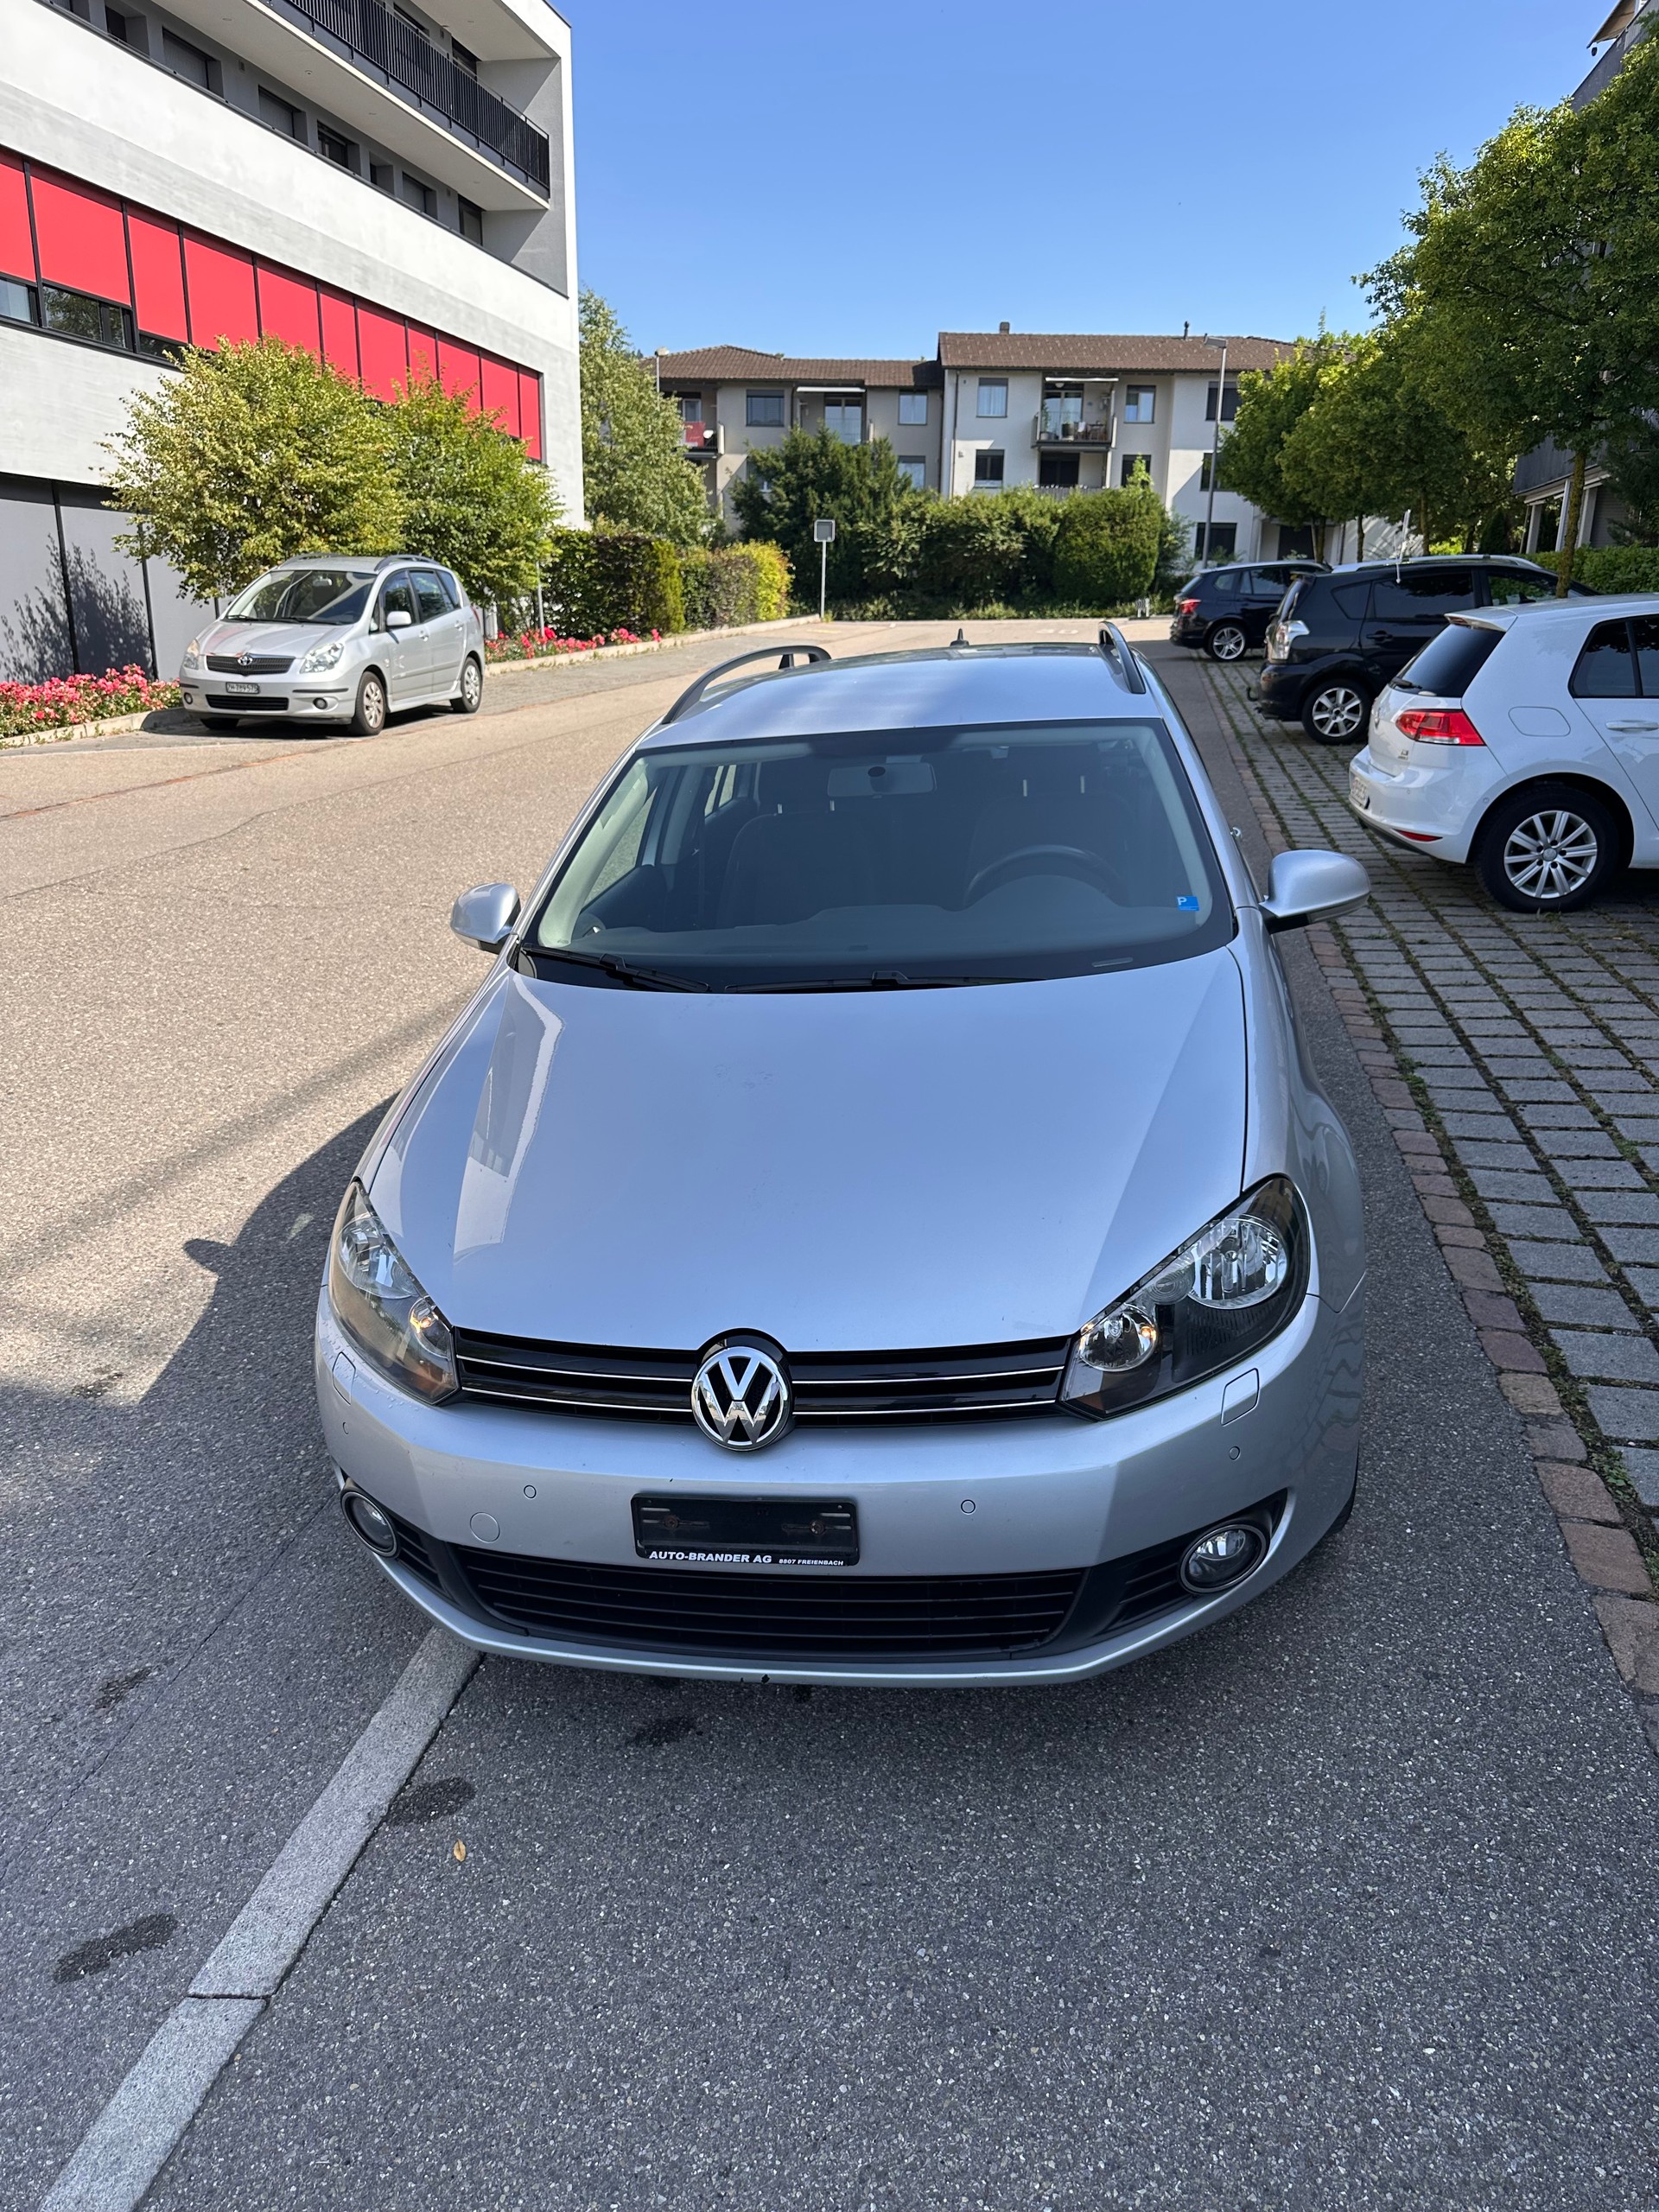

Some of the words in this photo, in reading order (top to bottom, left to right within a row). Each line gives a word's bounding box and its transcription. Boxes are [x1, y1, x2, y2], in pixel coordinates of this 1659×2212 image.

[1177, 897, 1187, 906] P
[693, 1347, 786, 1449] VW
[649, 1551, 750, 1563] AUTO-BRANDER
[753, 1554, 772, 1563] AG
